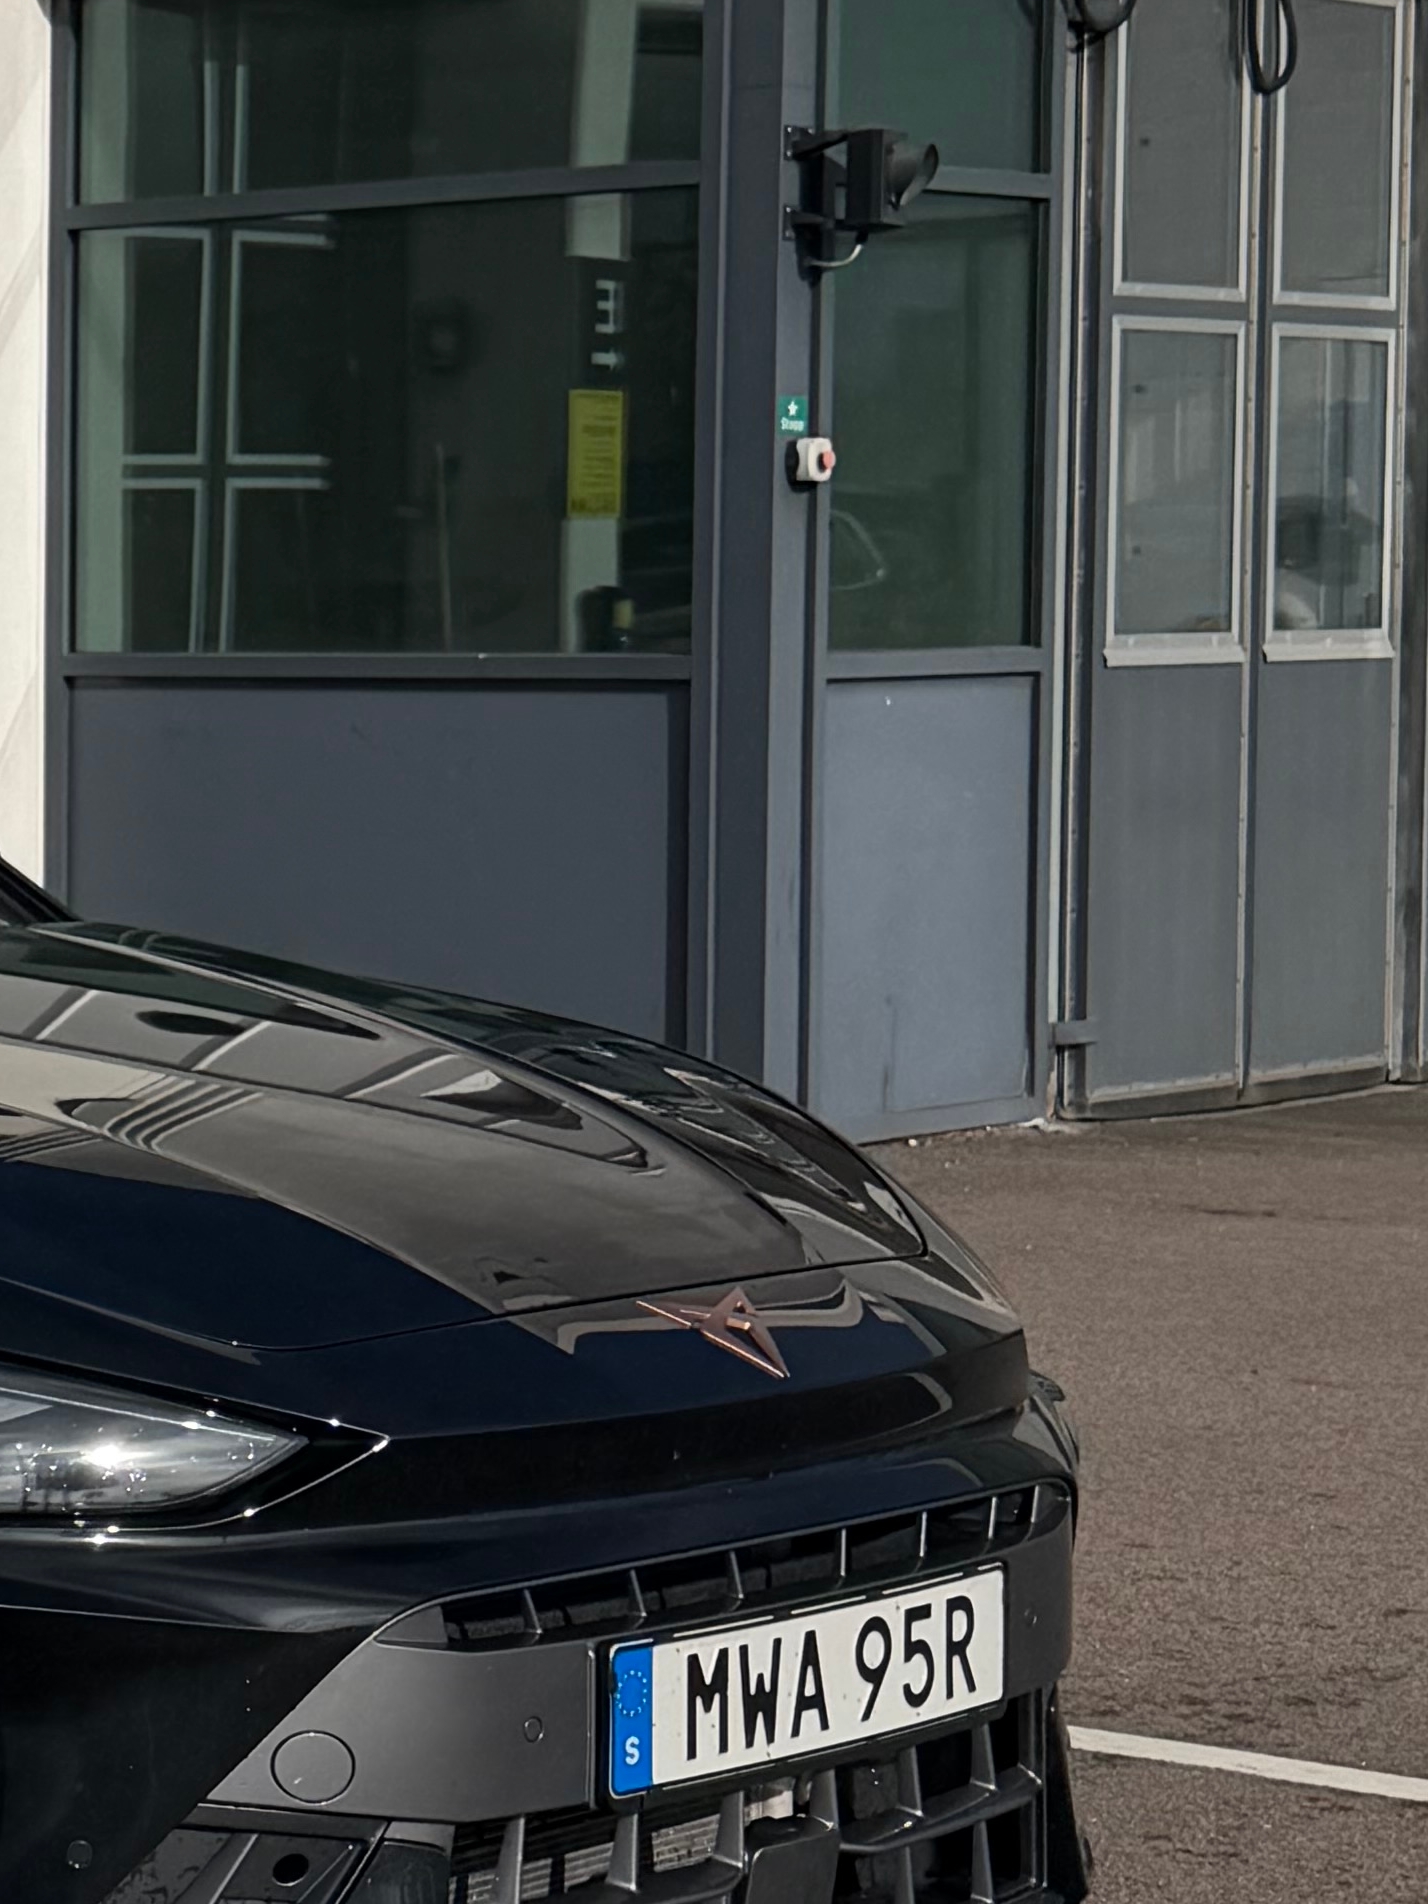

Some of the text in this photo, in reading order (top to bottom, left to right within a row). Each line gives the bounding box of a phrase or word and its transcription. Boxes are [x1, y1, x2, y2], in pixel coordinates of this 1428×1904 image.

[686, 1594, 978, 1761] MWA 95R
[624, 1736, 640, 1766] S
